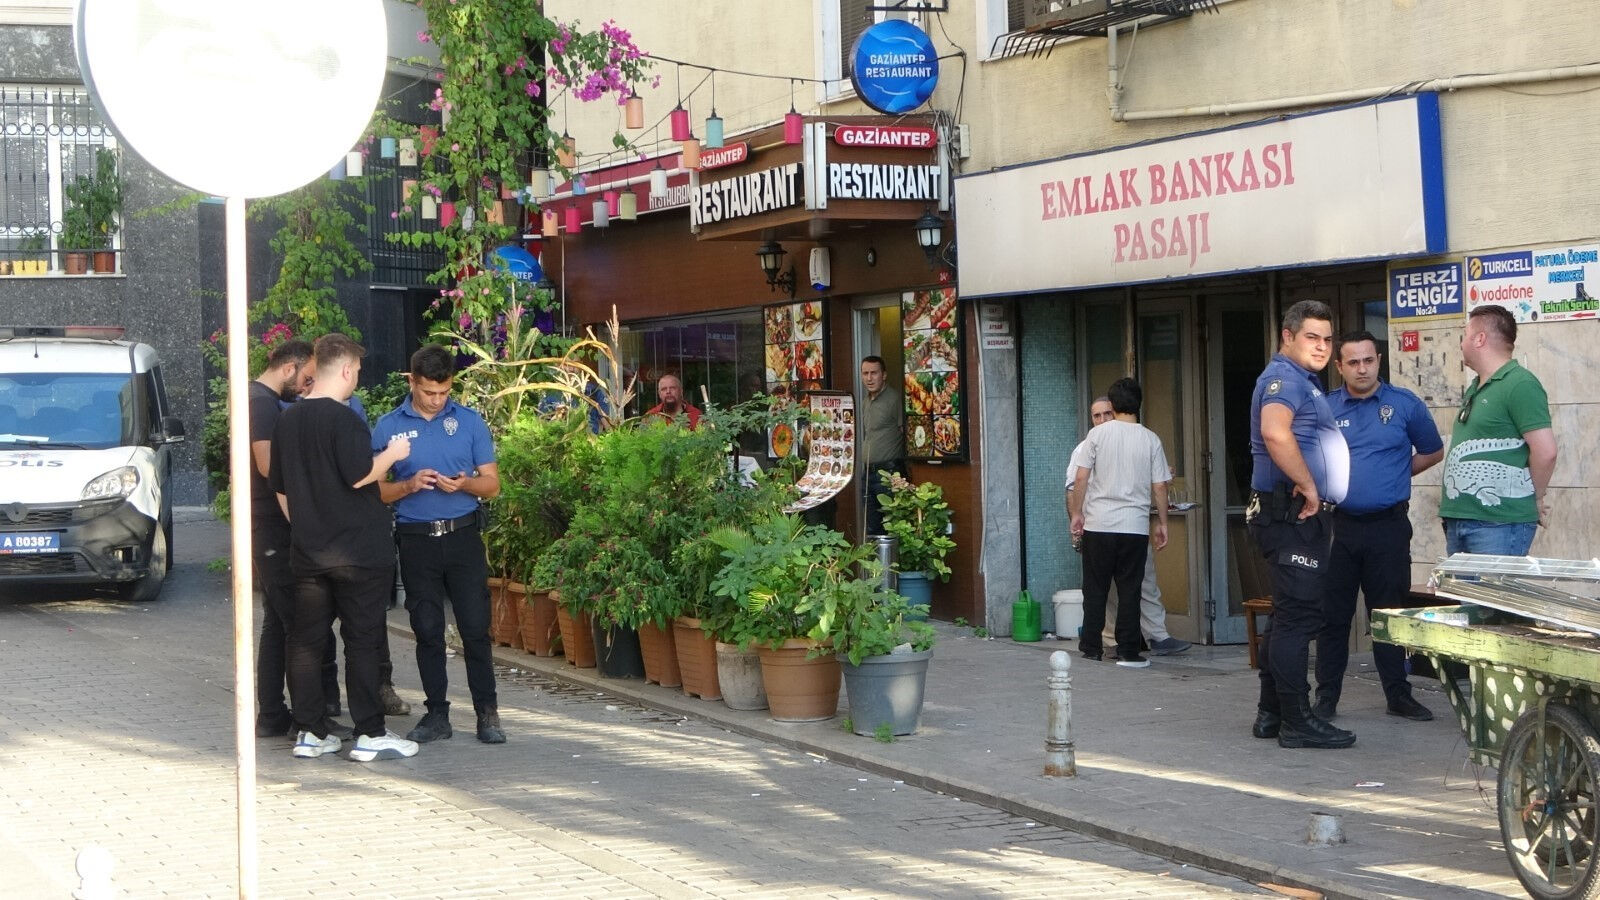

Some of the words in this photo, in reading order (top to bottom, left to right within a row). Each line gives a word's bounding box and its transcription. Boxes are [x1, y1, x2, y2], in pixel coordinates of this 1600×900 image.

[870, 52, 926, 64] GAZİANTEP
[866, 67, 931, 77] RESTAURANT
[842, 129, 931, 146] GAZİANTEP
[830, 163, 941, 199] RESTAURANT
[1040, 168, 1142, 221] EMLAK
[1148, 141, 1295, 205] BANKASI
[649, 184, 689, 210] RESTAURAN
[690, 163, 798, 225] RESTAURANT
[1114, 212, 1211, 268] PASAJI
[1483, 258, 1532, 274] TURKCELL
[1396, 266, 1457, 288] TERZİ
[1396, 284, 1458, 308] CENGİZ
[1481, 284, 1533, 302] vodafone
[1415, 307, 1437, 315] No:24
[1335, 419, 1350, 427] LIS
[4, 537, 12, 547] A
